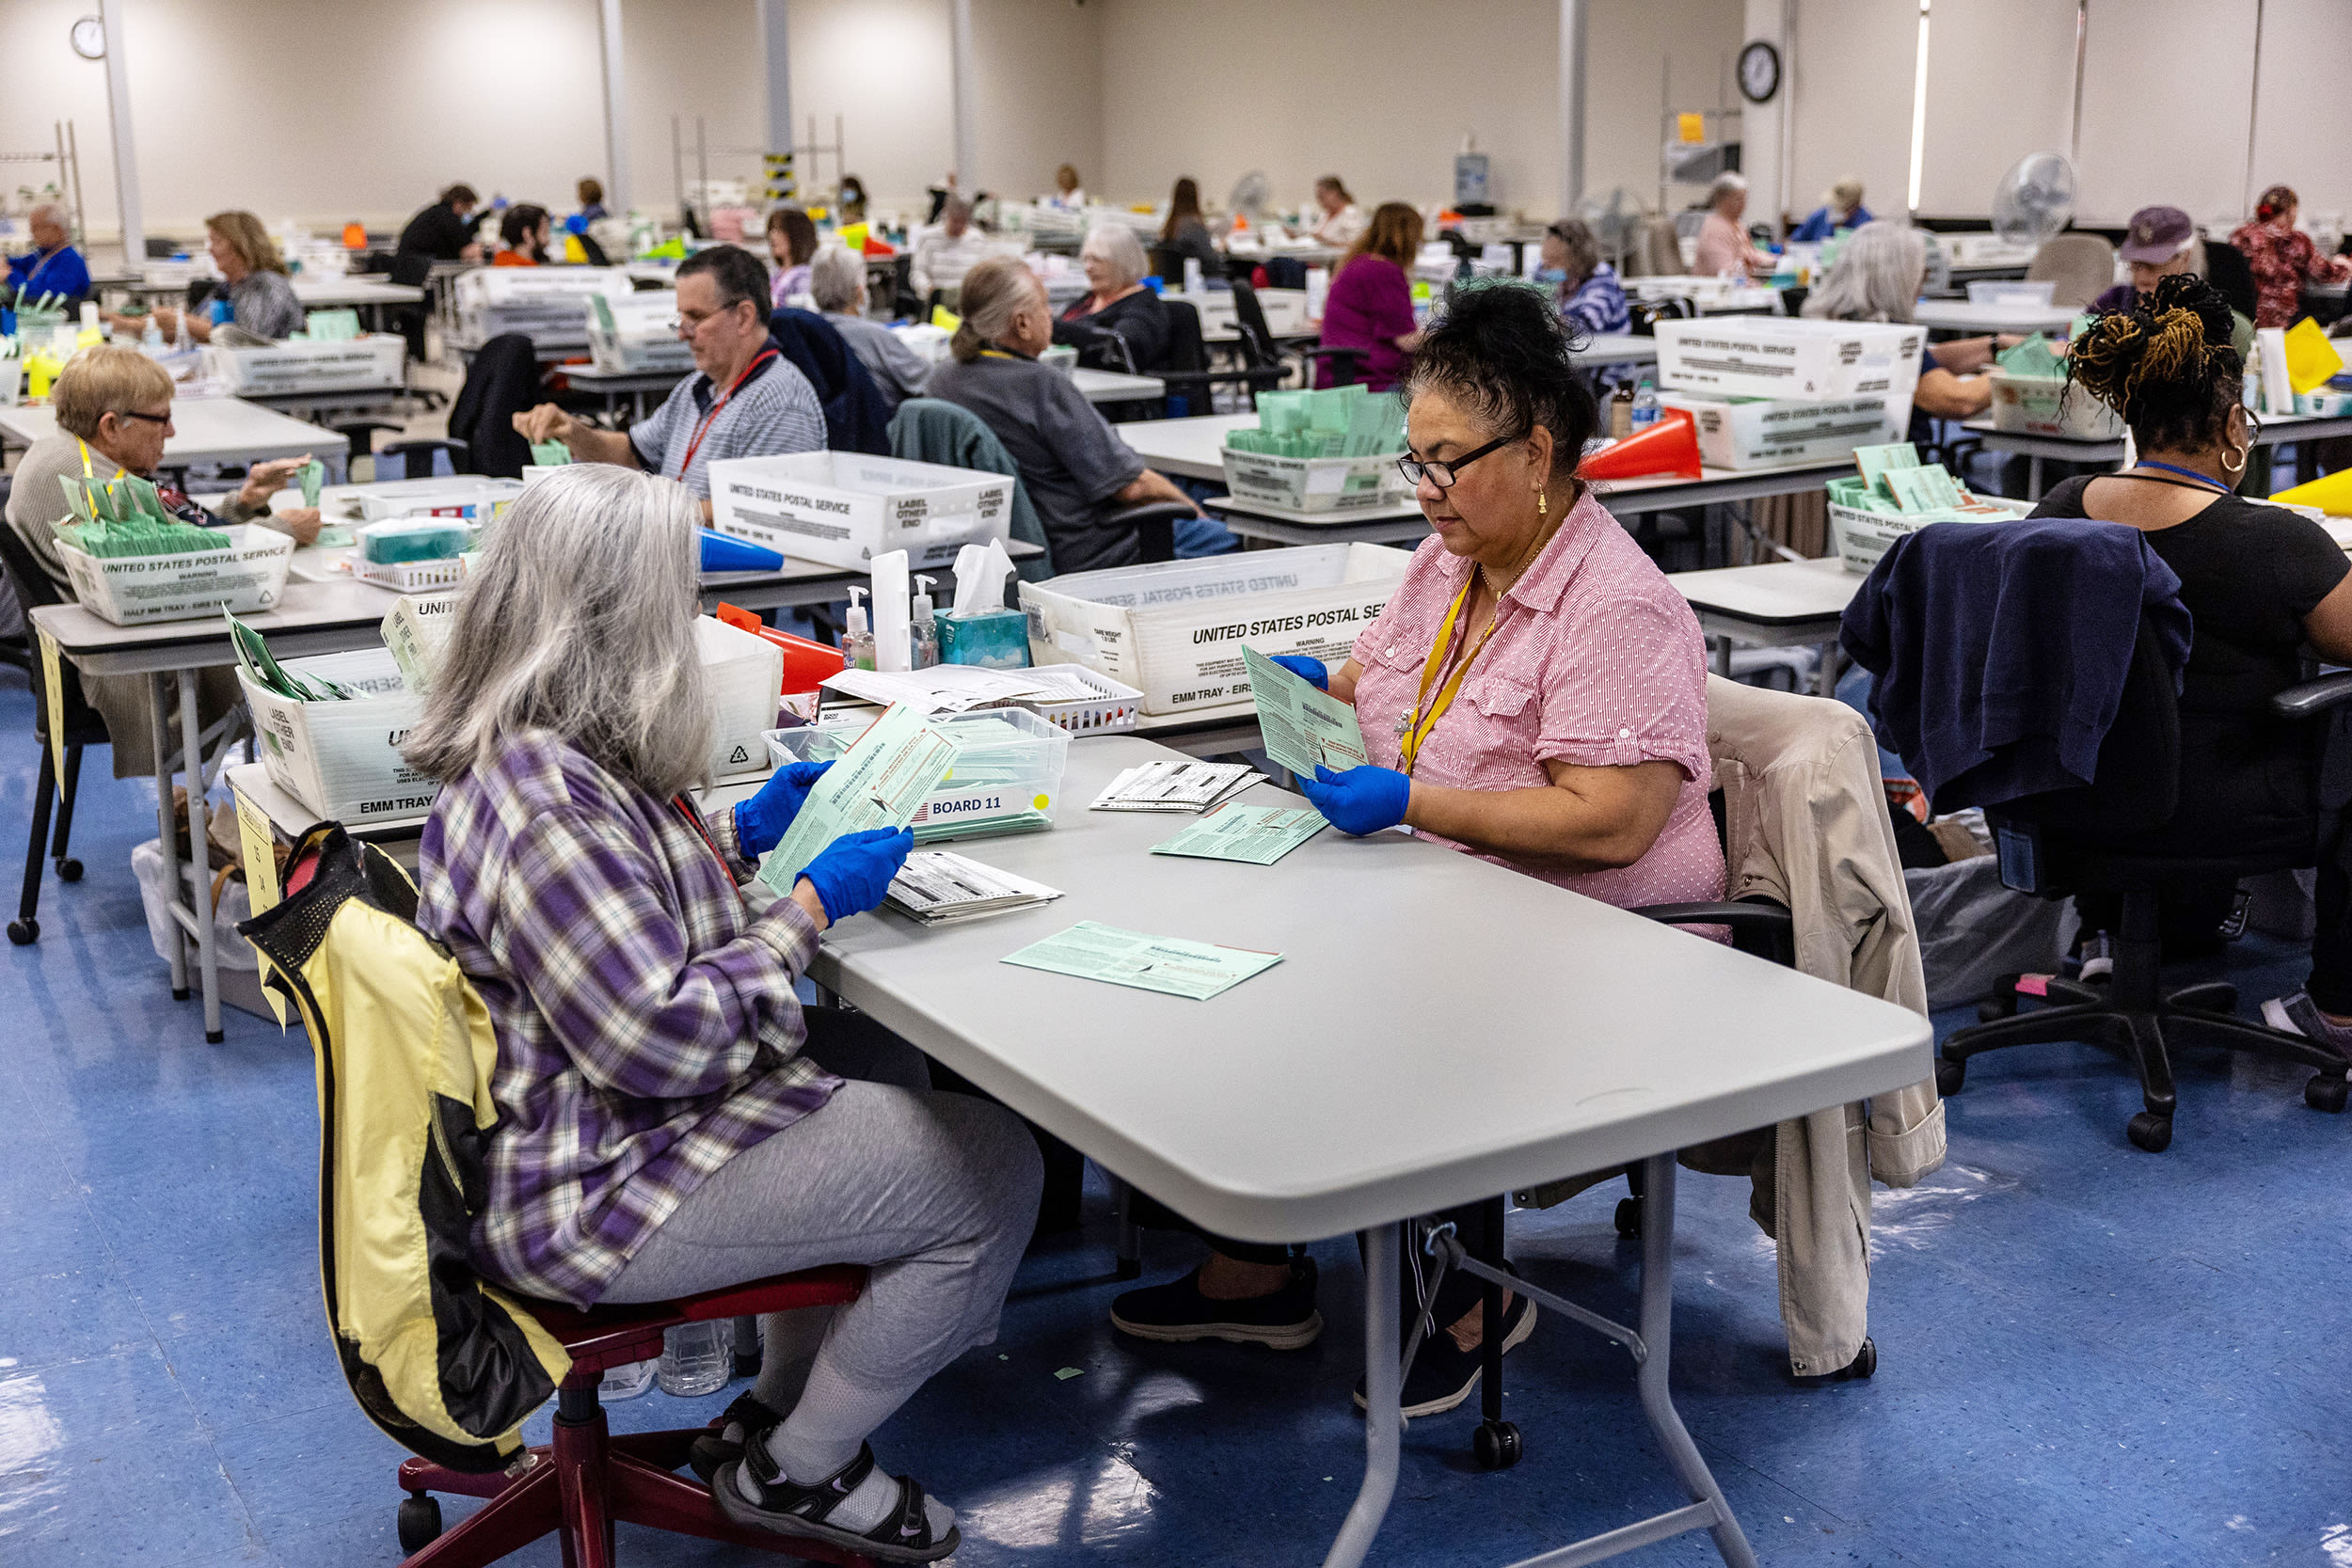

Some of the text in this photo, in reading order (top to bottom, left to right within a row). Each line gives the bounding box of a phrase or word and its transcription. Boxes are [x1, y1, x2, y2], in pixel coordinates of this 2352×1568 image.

[730, 483, 850, 515] UNITED STATES POSTAL SERVICE
[978, 488, 1003, 500] LABEL
[898, 499, 928, 509] LABEL
[977, 498, 1004, 510] OTHER
[897, 508, 928, 519] OTHER
[981, 508, 998, 518] END
[901, 518, 921, 529] END
[1857, 514, 1883, 526] STATES
[1885, 518, 1913, 531] POSTAL
[102, 546, 287, 575] UNITED STATES POSTAL SERVICE
[178, 570, 218, 580] WARNING
[419, 601, 453, 615] UNIT
[1193, 624, 1247, 644] UNITED
[1250, 615, 1303, 636] STATES
[1307, 608, 1359, 627] POSTAL
[1295, 637, 1325, 647] WARNING
[1172, 691, 1196, 705] EMM
[1198, 687, 1224, 700] TRAY
[268, 706, 290, 724] LABEL
[273, 721, 294, 739] OTHER
[280, 736, 294, 752] END
[360, 796, 434, 814] EMM TRAY
[932, 797, 1001, 815] BOARD 11
